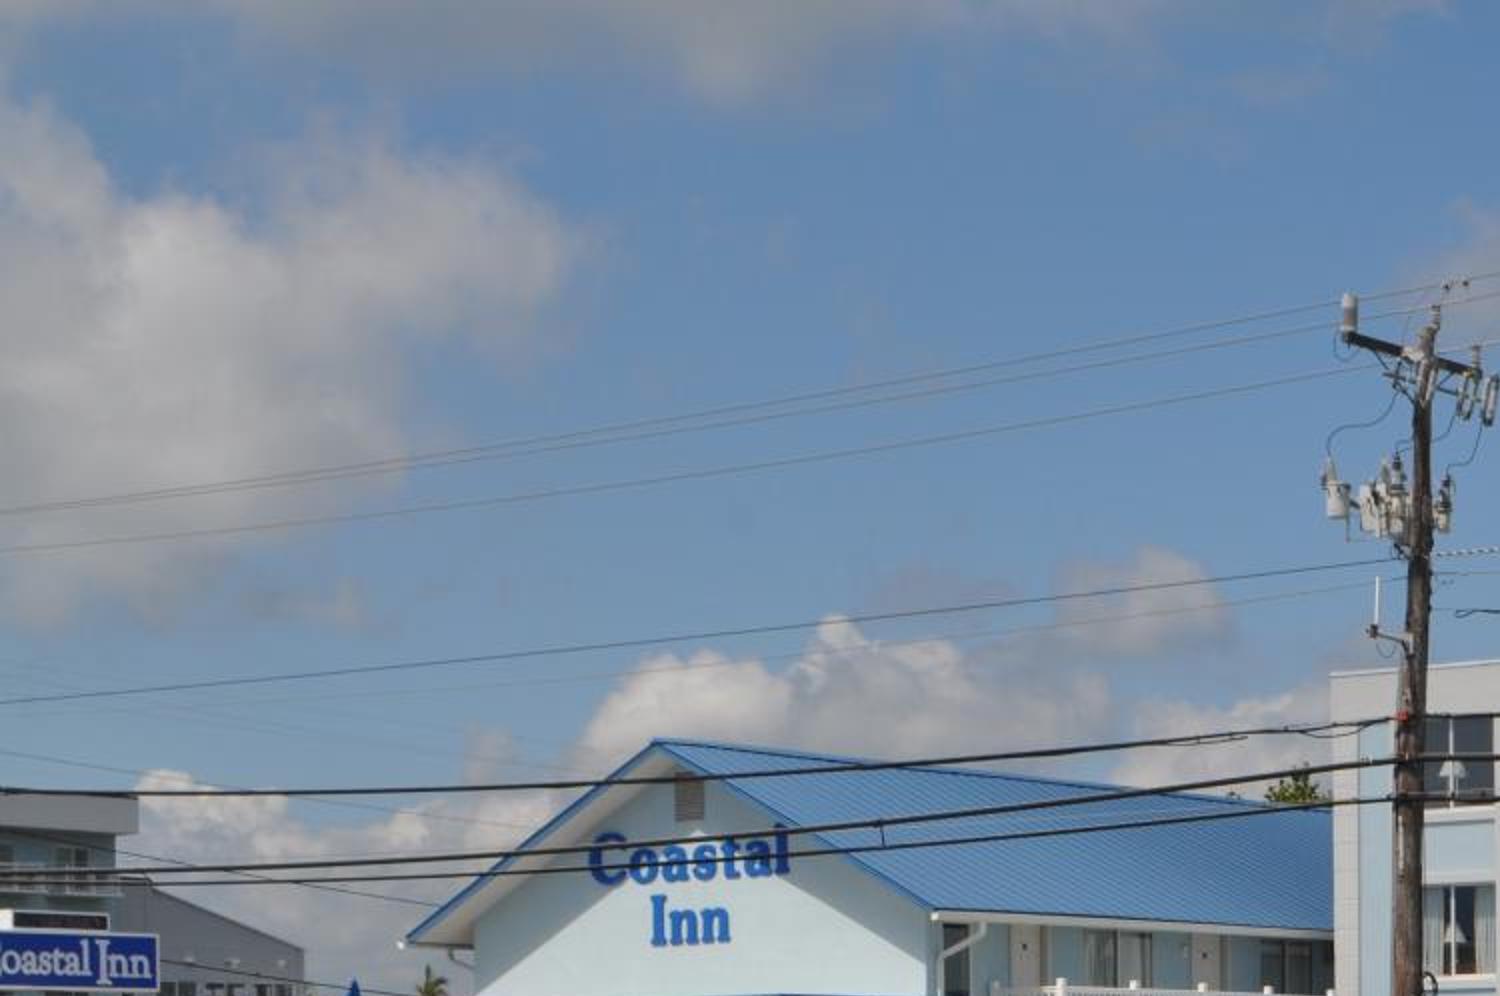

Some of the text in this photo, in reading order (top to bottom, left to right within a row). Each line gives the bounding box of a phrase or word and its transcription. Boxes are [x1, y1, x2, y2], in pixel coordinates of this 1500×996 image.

[588, 823, 791, 886] Coastal
[650, 894, 732, 947] Inn
[0, 938, 153, 986] oastal Inn
